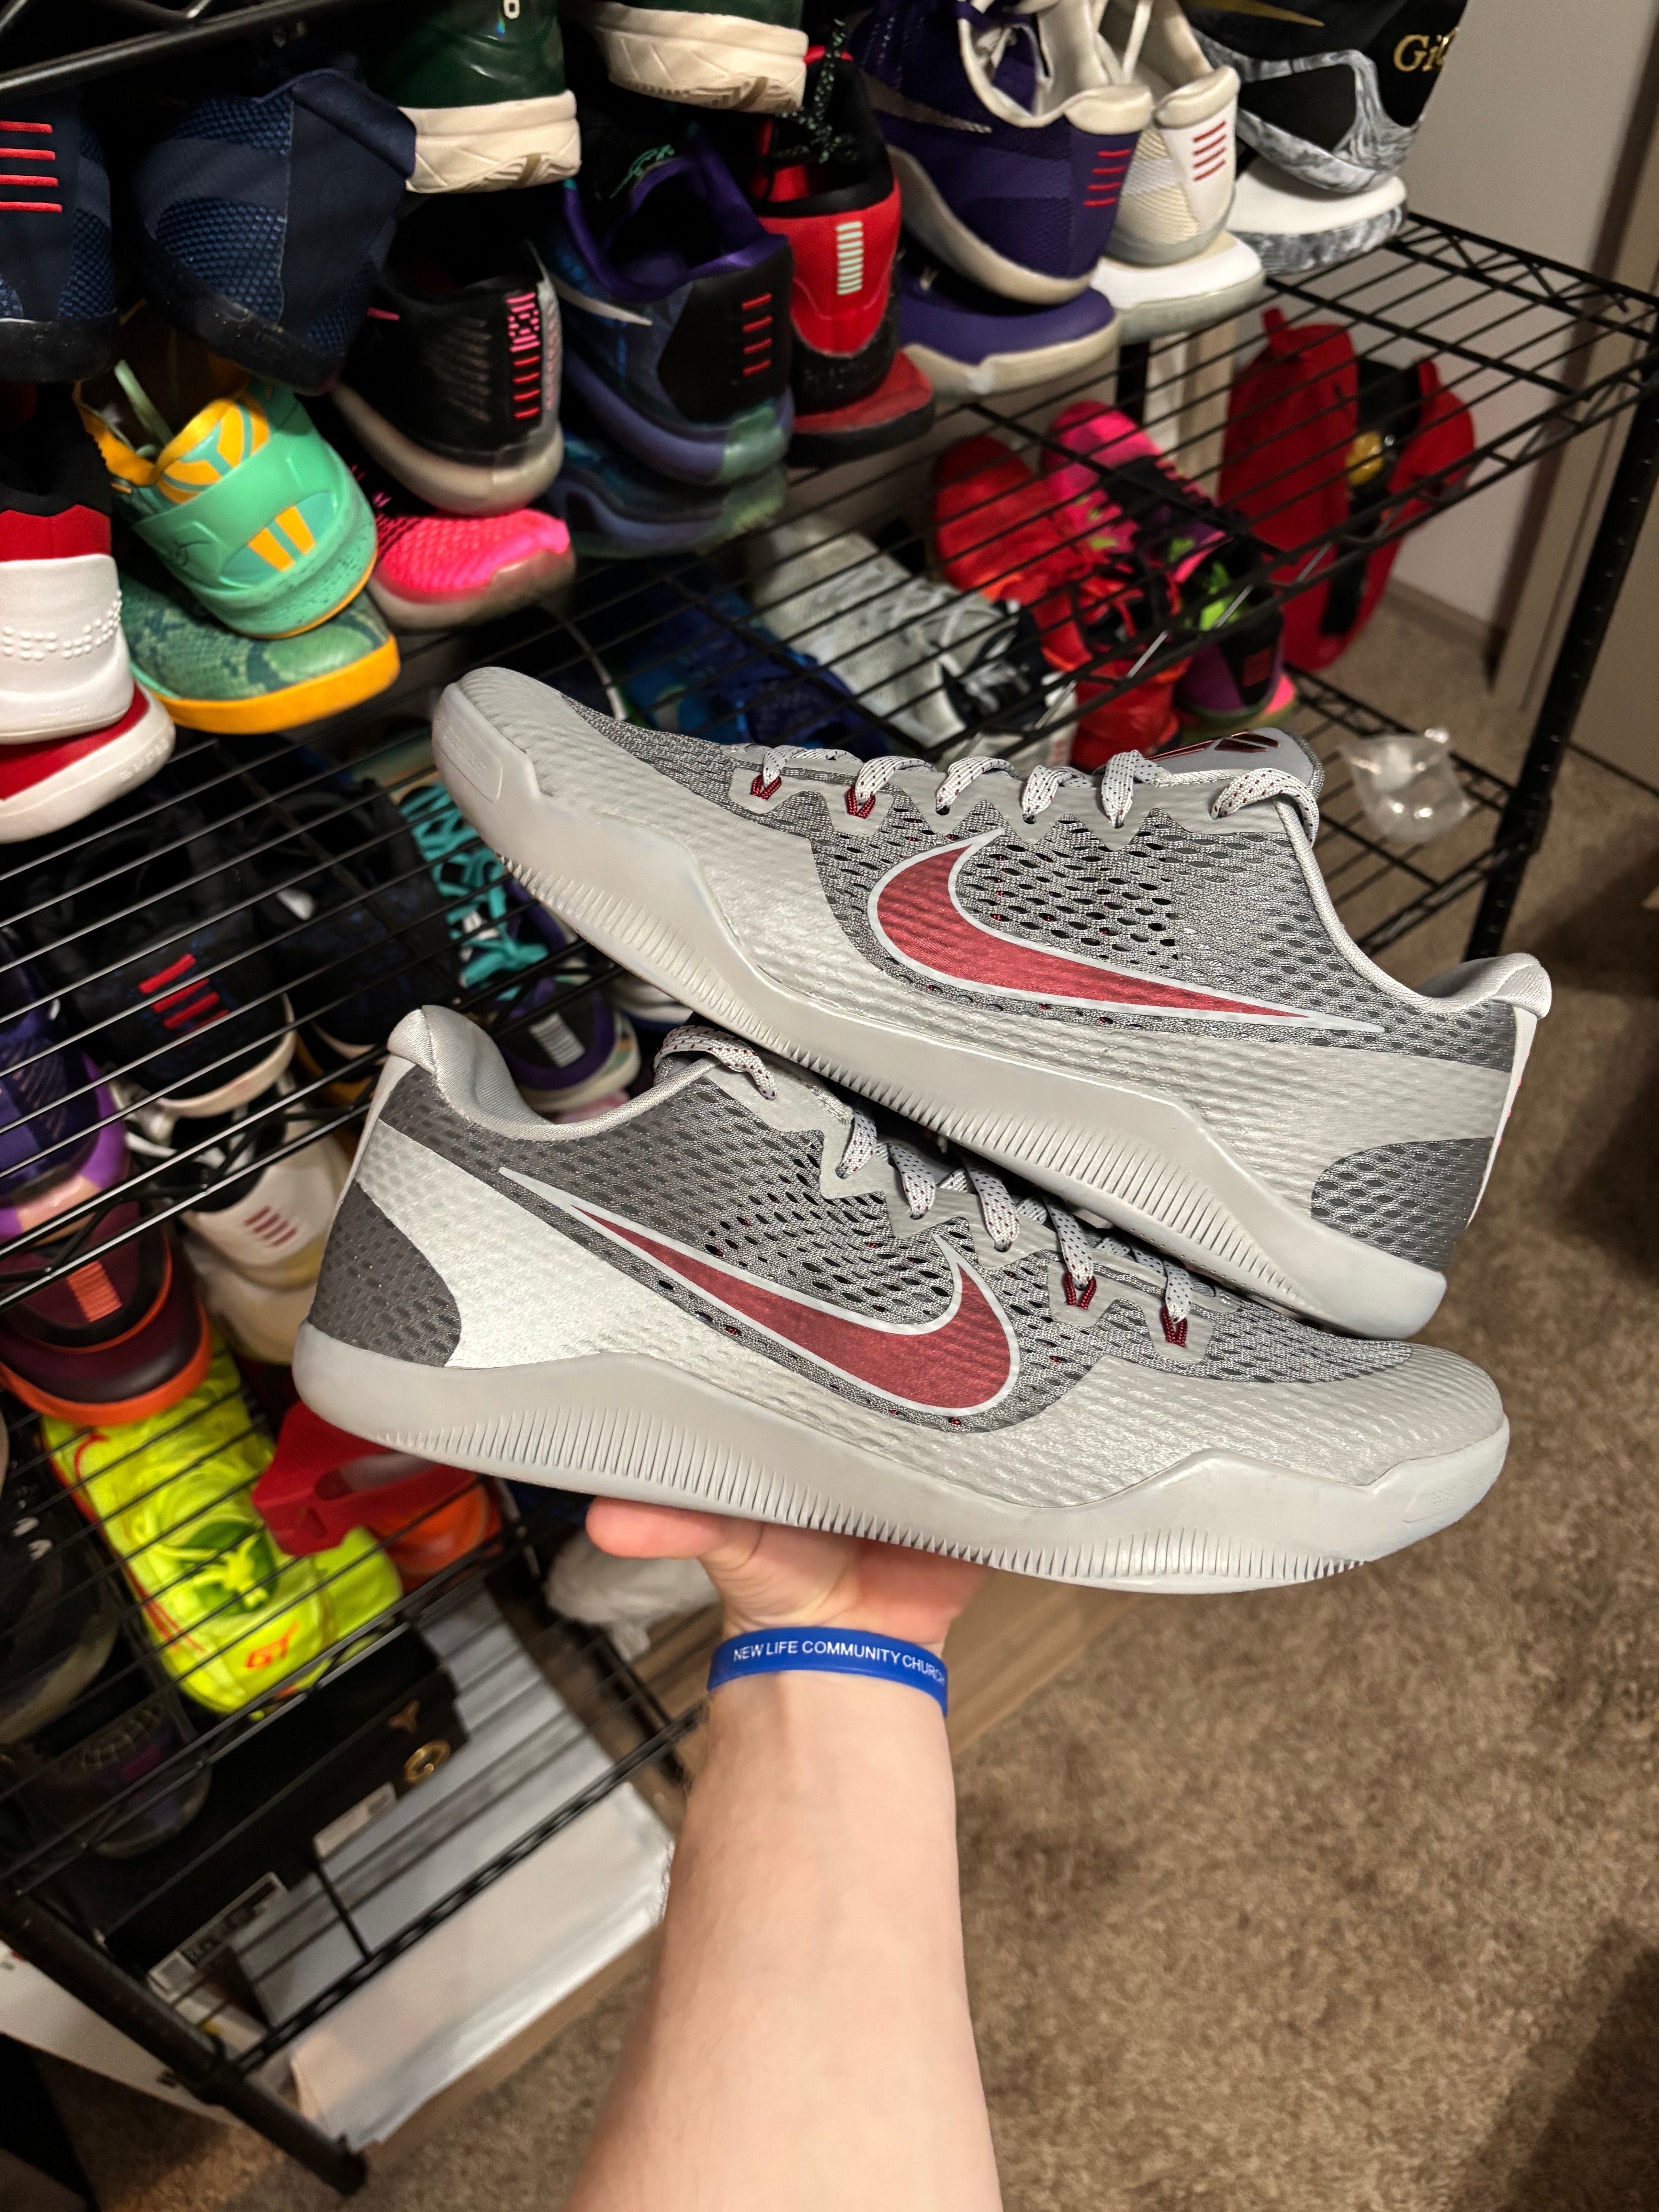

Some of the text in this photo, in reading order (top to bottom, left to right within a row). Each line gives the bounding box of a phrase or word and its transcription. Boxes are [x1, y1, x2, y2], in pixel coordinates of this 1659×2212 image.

[733, 1643, 764, 1662] NEW
[766, 1640, 799, 1656] LIFE
[802, 1640, 901, 1665] COMMUNITY
